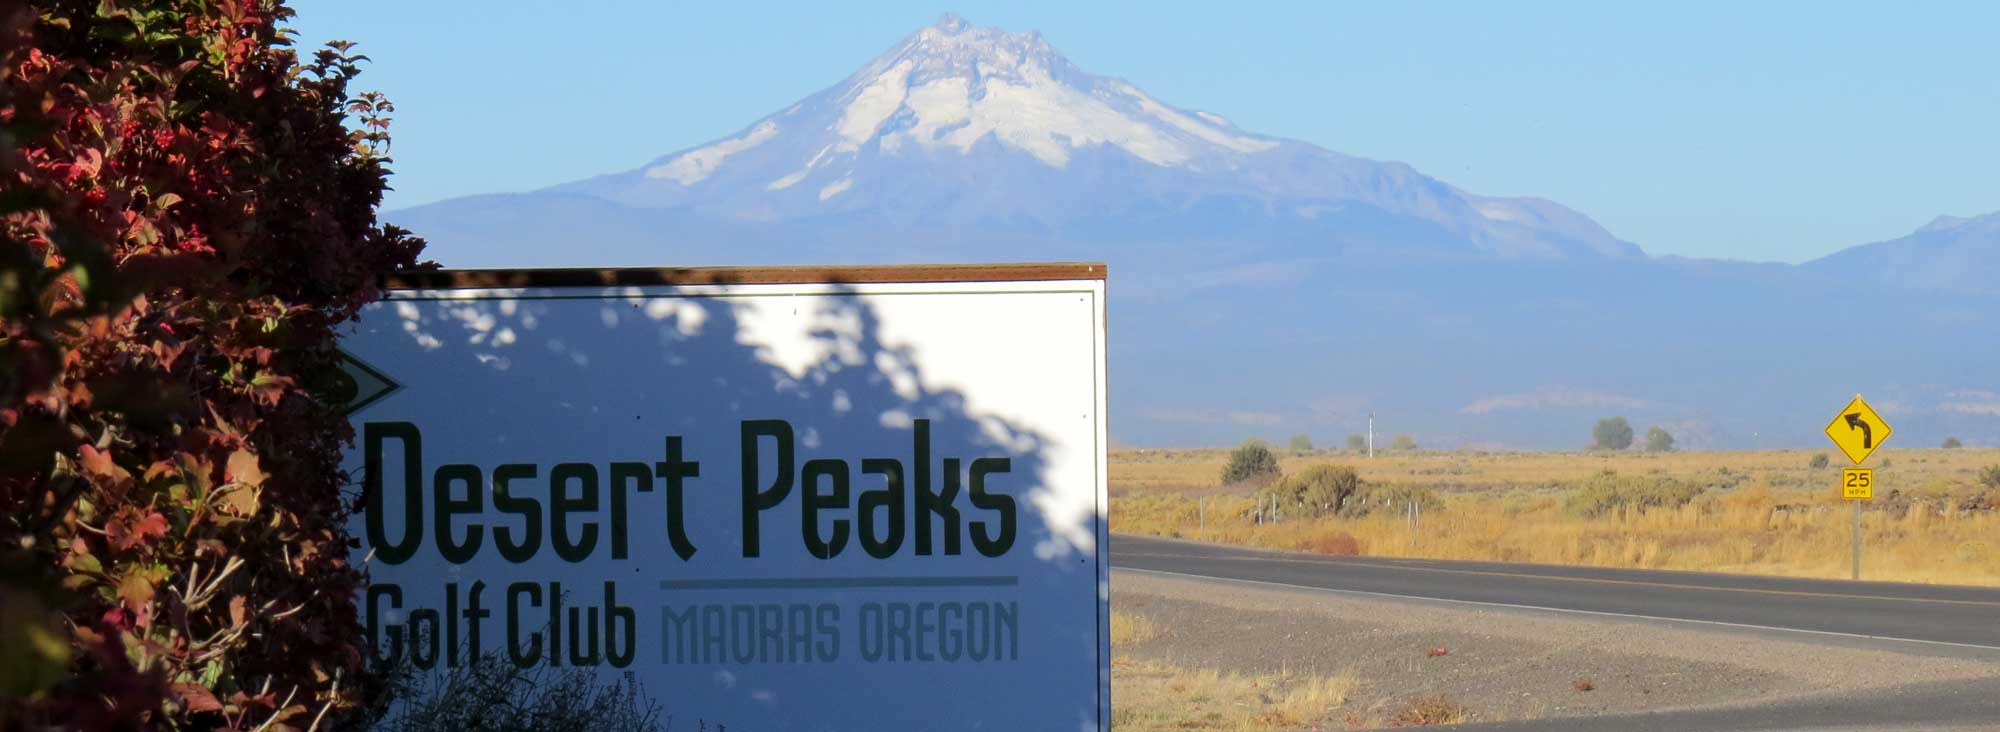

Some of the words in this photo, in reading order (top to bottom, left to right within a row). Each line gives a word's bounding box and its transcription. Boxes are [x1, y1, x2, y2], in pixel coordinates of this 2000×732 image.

[364, 421, 699, 565] Desert
[741, 419, 1017, 560] Peaks
[1846, 472, 1870, 488] 25
[366, 579, 490, 670] Golf
[506, 580, 636, 669] Club
[661, 602, 841, 665] MADRAS
[859, 600, 1019, 664] OREGON
